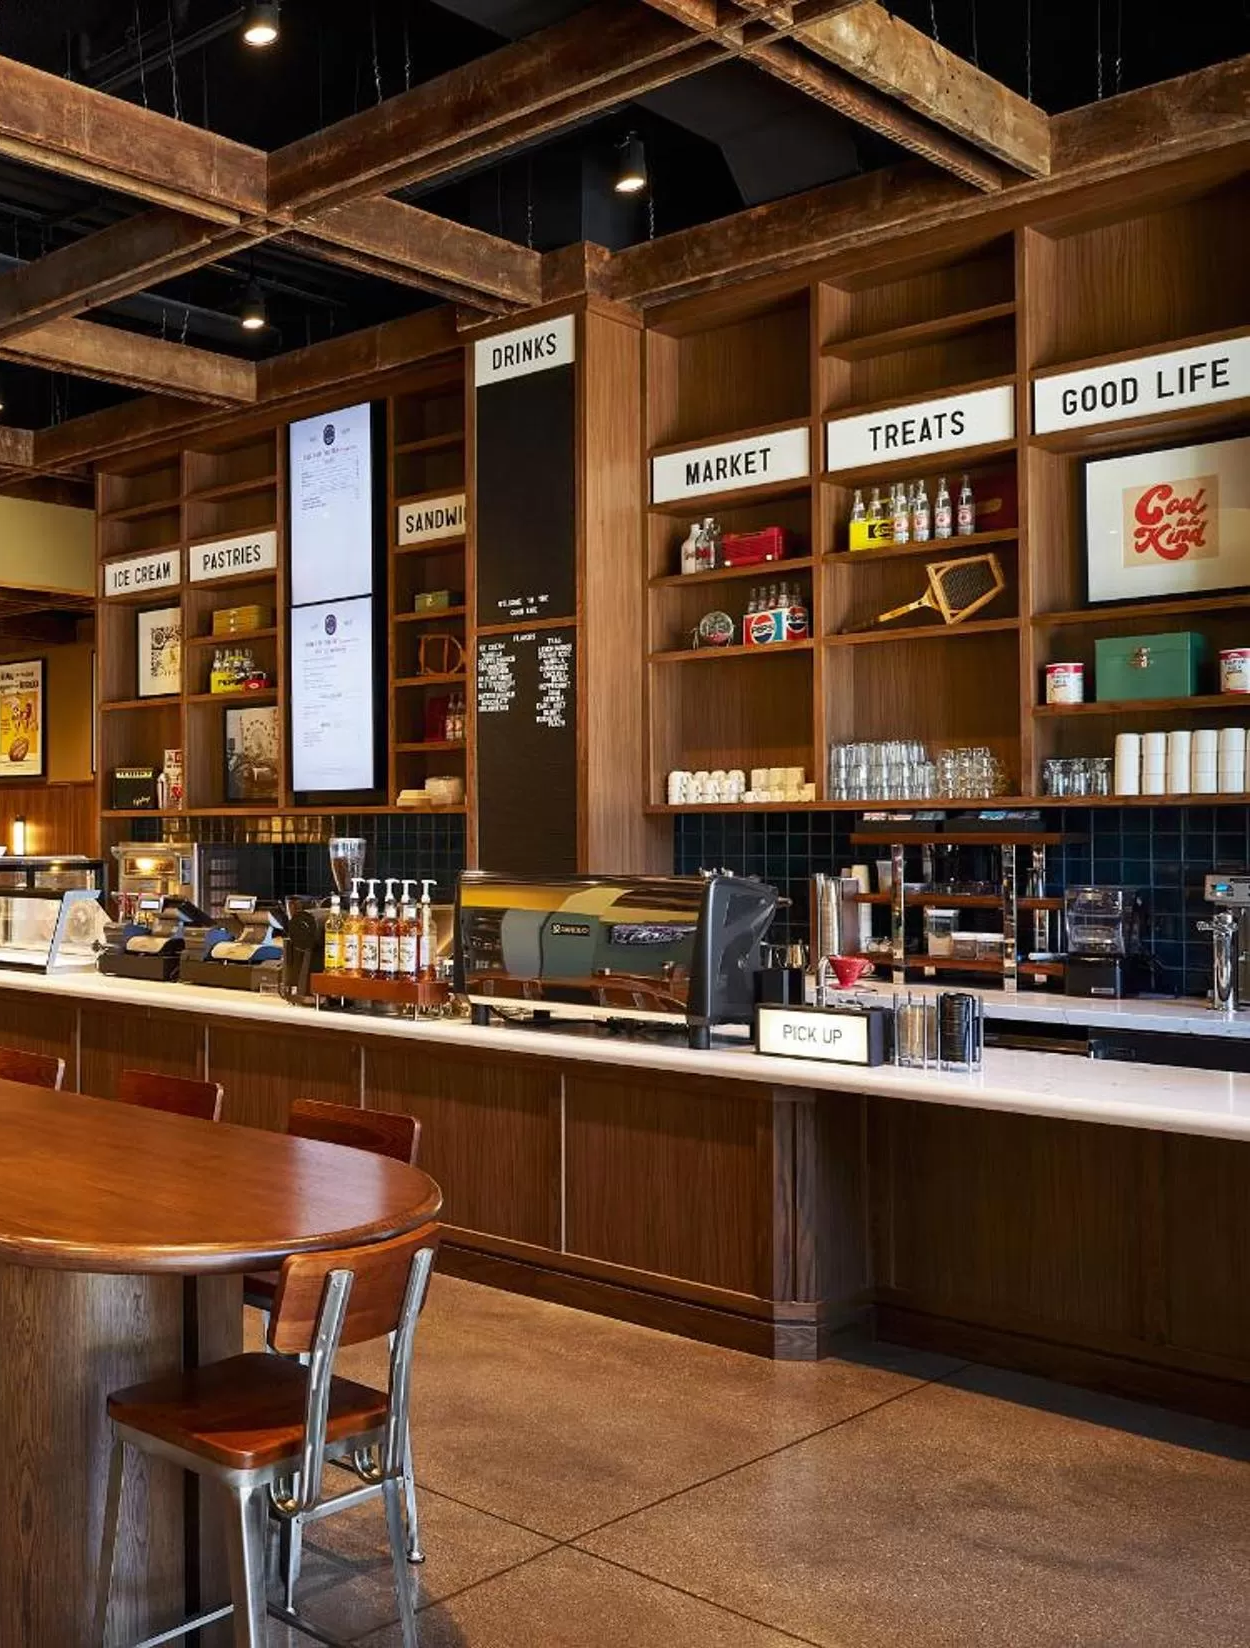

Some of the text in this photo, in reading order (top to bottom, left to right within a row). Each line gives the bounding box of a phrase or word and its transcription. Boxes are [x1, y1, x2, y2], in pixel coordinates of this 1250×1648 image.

[492, 333, 557, 370] DRINKS
[1062, 358, 1230, 416] GOOD LIFE
[869, 411, 965, 451] TREATS
[686, 448, 771, 486] MARKET
[405, 506, 467, 534] SANDWI
[203, 545, 261, 571] PASTRIES
[1134, 520, 1207, 560] Kind
[114, 562, 171, 588] ICE CREAM
[783, 1024, 843, 1045] PICK UP
